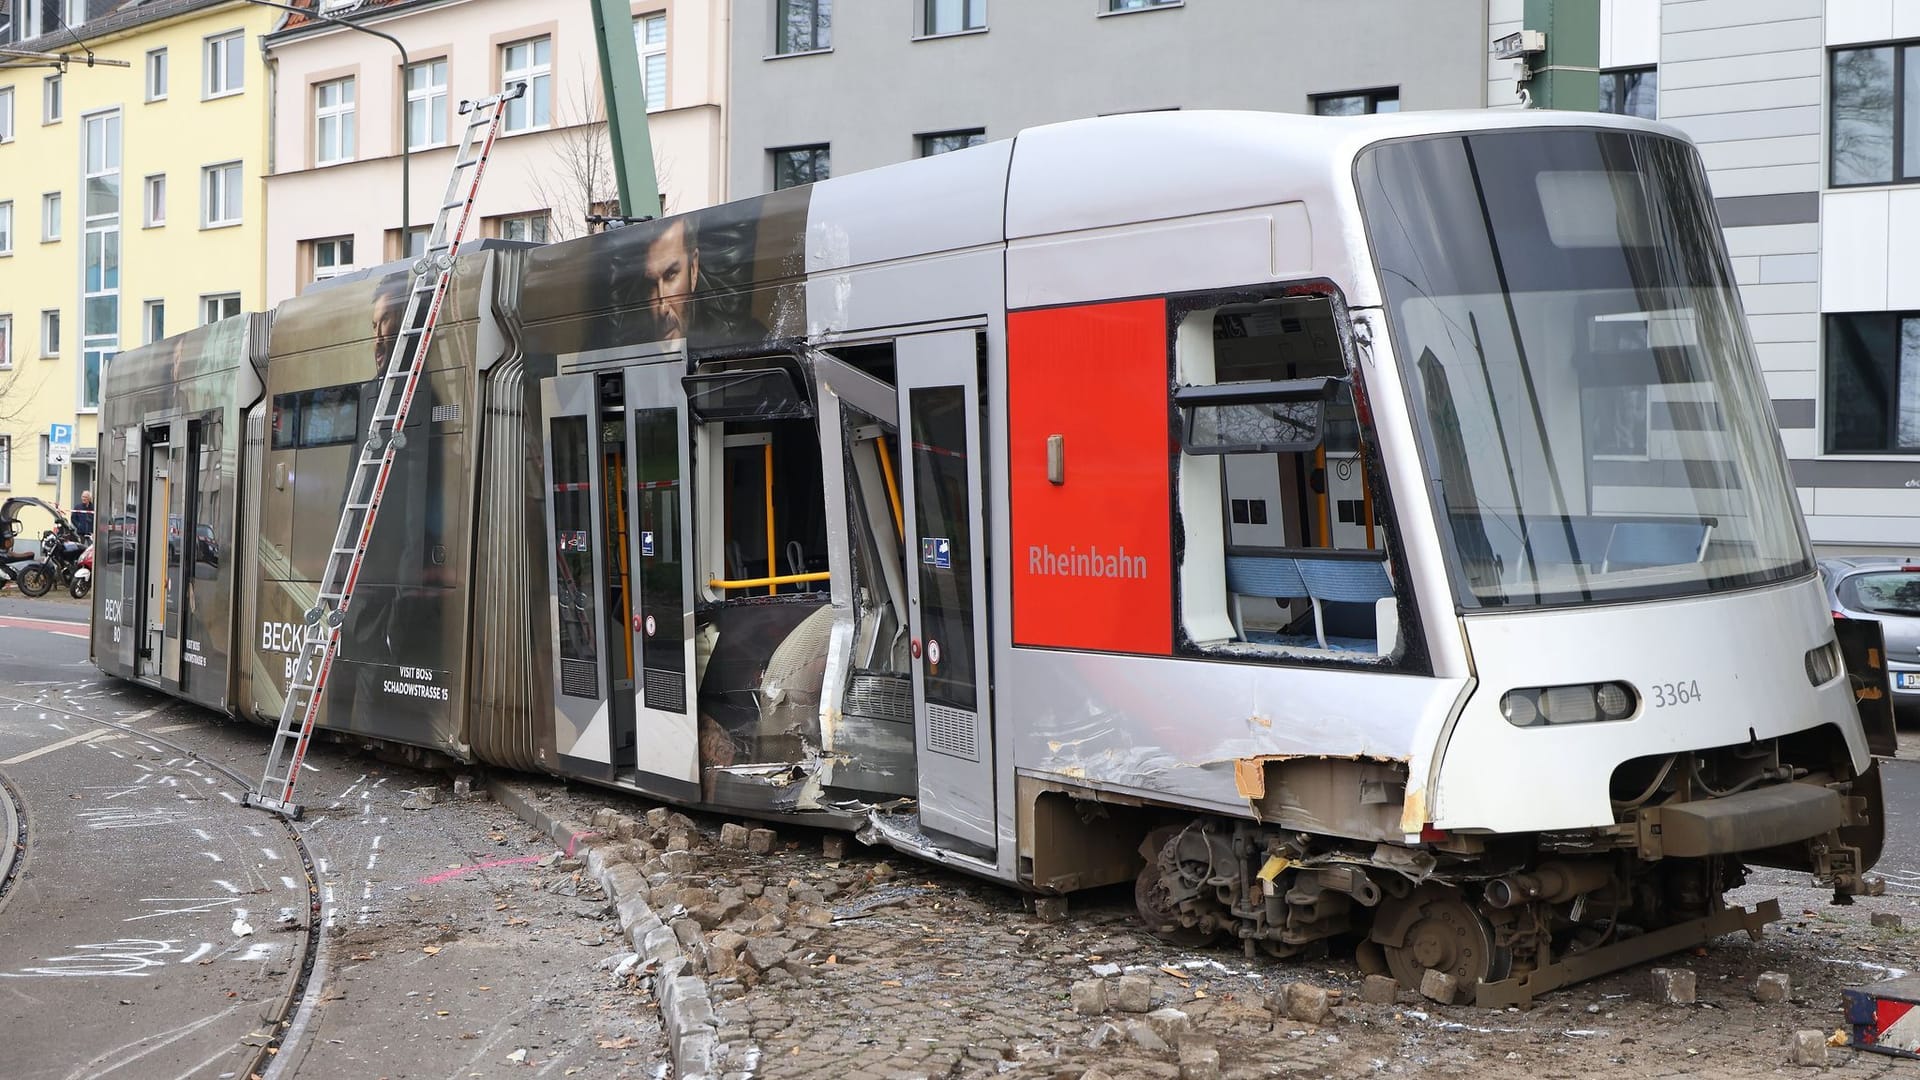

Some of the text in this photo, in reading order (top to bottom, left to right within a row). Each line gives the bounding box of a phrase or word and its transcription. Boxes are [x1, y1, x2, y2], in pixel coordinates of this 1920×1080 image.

[54, 426, 67, 443] P
[1029, 544, 1147, 579] Rheinbahn
[285, 657, 313, 682] BOS
[399, 666, 433, 681] VISIT BOSS
[383, 680, 449, 701] SCHADOWSTRASSE 15
[1652, 679, 1702, 708] 3364
